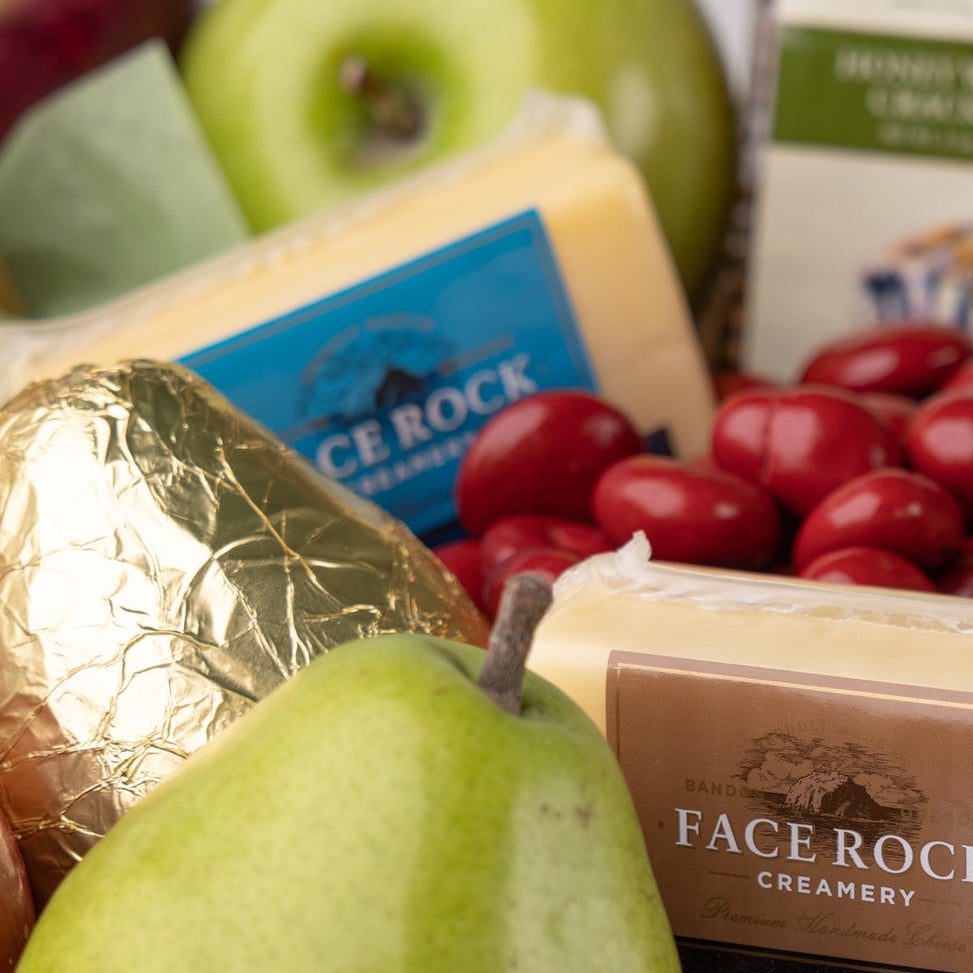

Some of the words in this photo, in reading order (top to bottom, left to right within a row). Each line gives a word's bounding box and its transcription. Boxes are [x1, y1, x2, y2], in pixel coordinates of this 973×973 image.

[316, 419, 391, 479] CE
[391, 353, 538, 450] ROCK
[675, 807, 817, 865] FACE
[757, 871, 916, 908] CREAMERY
[700, 896, 787, 929] Premium
[794, 910, 897, 944] Handmade
[903, 920, 967, 953] Cheese
